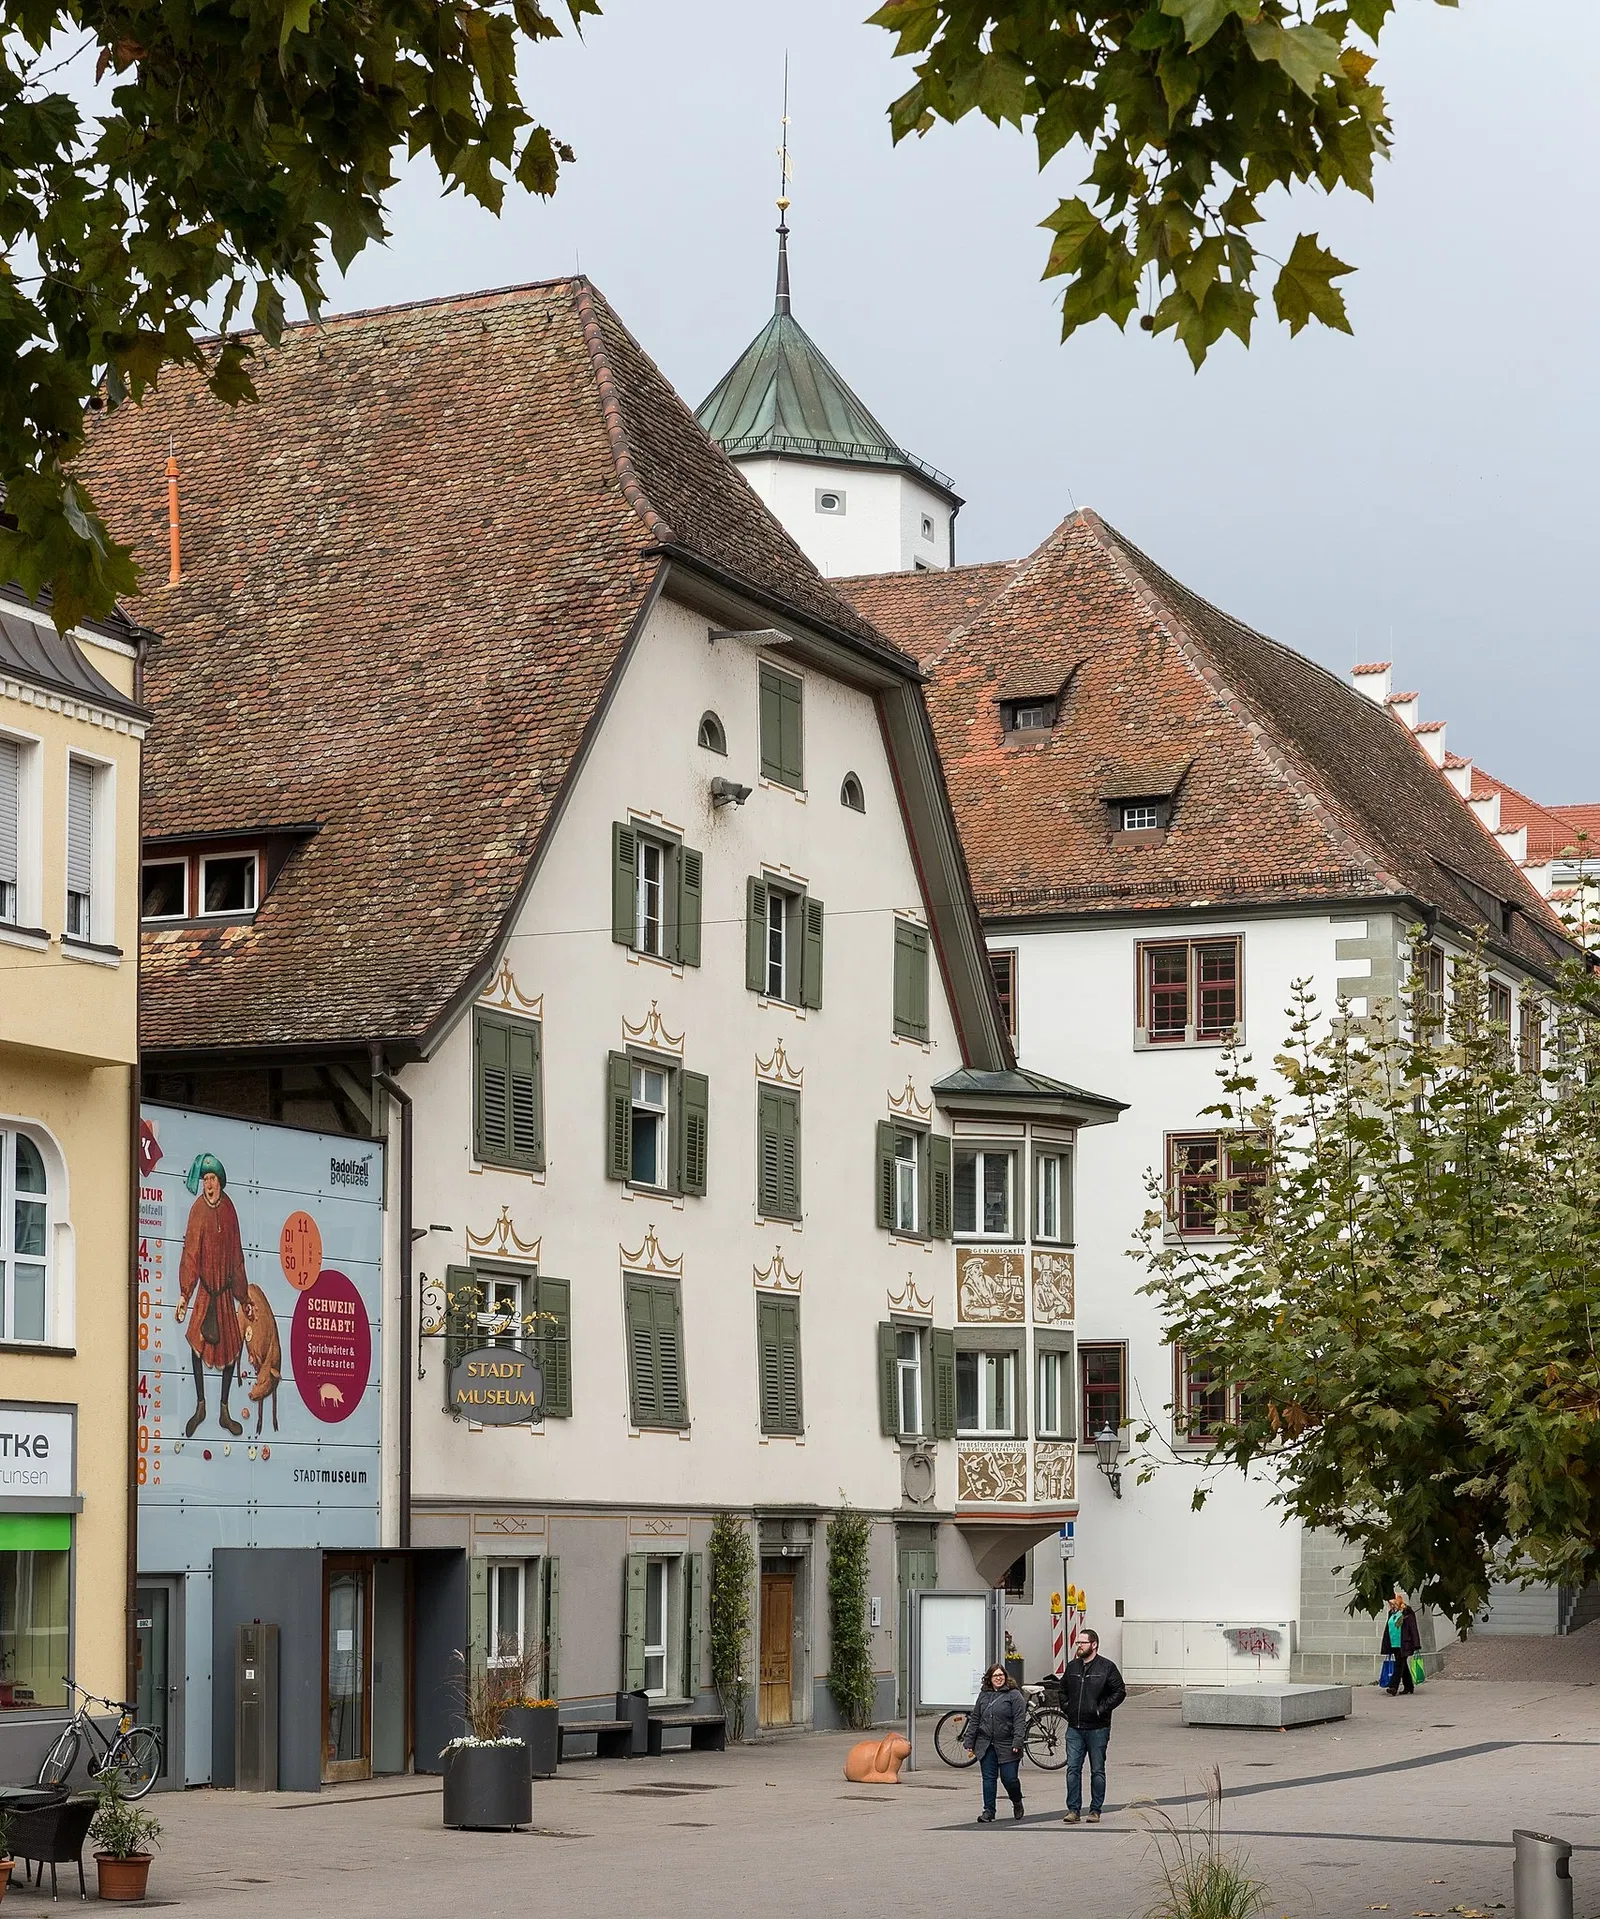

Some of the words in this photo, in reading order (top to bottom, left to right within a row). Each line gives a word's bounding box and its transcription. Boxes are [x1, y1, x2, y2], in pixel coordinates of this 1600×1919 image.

[331, 1157, 369, 1176] Radolfzell
[298, 1218, 309, 1233] 11
[285, 1229, 294, 1243] DI
[285, 1256, 296, 1270] SO
[298, 1271, 308, 1286] 17
[308, 1298, 355, 1315] SCHWEIN
[308, 1317, 355, 1333] GEHABT!
[308, 1342, 349, 1356] Sprichwörter
[349, 1347, 355, 1356] &
[308, 1356, 355, 1370] Redensarten
[467, 1362, 526, 1379] STADT
[456, 1389, 535, 1406] MUSEUM
[293, 1469, 367, 1484] STADTmuseum
